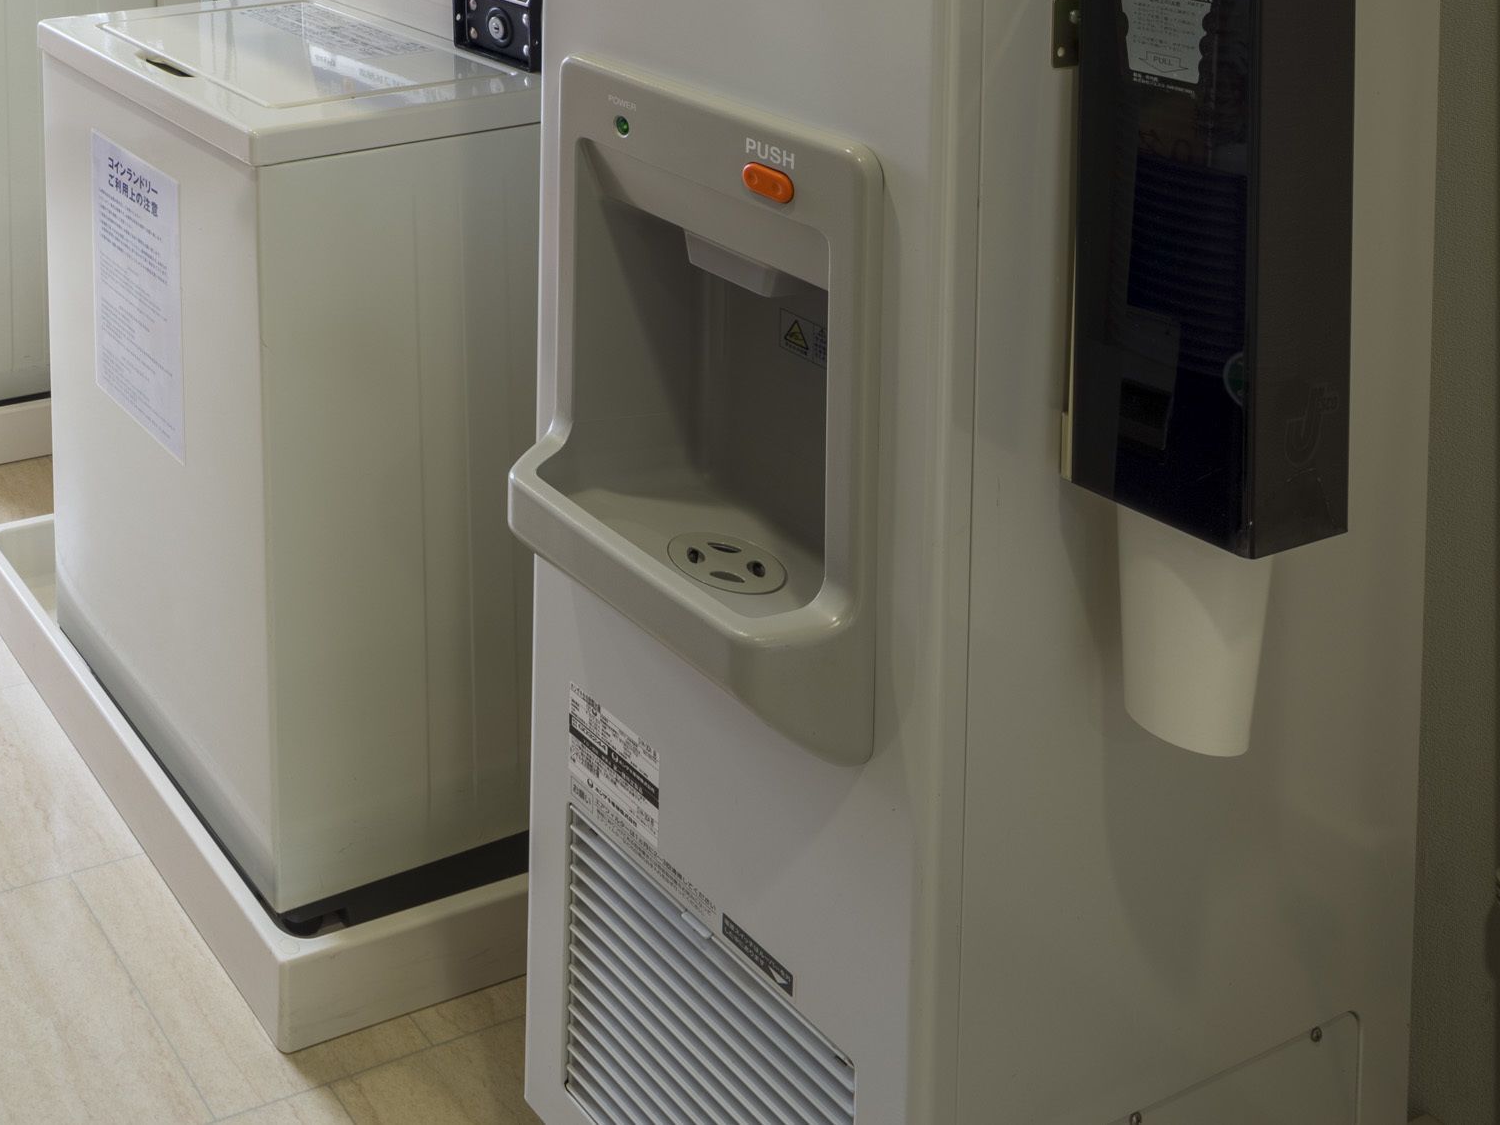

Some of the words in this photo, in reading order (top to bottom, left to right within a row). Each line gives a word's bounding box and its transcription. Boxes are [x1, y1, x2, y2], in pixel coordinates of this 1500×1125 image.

[1153, 55, 1173, 67] PULL
[607, 93, 637, 112] POWER
[745, 136, 796, 171] PUSH
[107, 156, 158, 196] コインランドリー
[108, 172, 159, 217] ご利用上の注意
